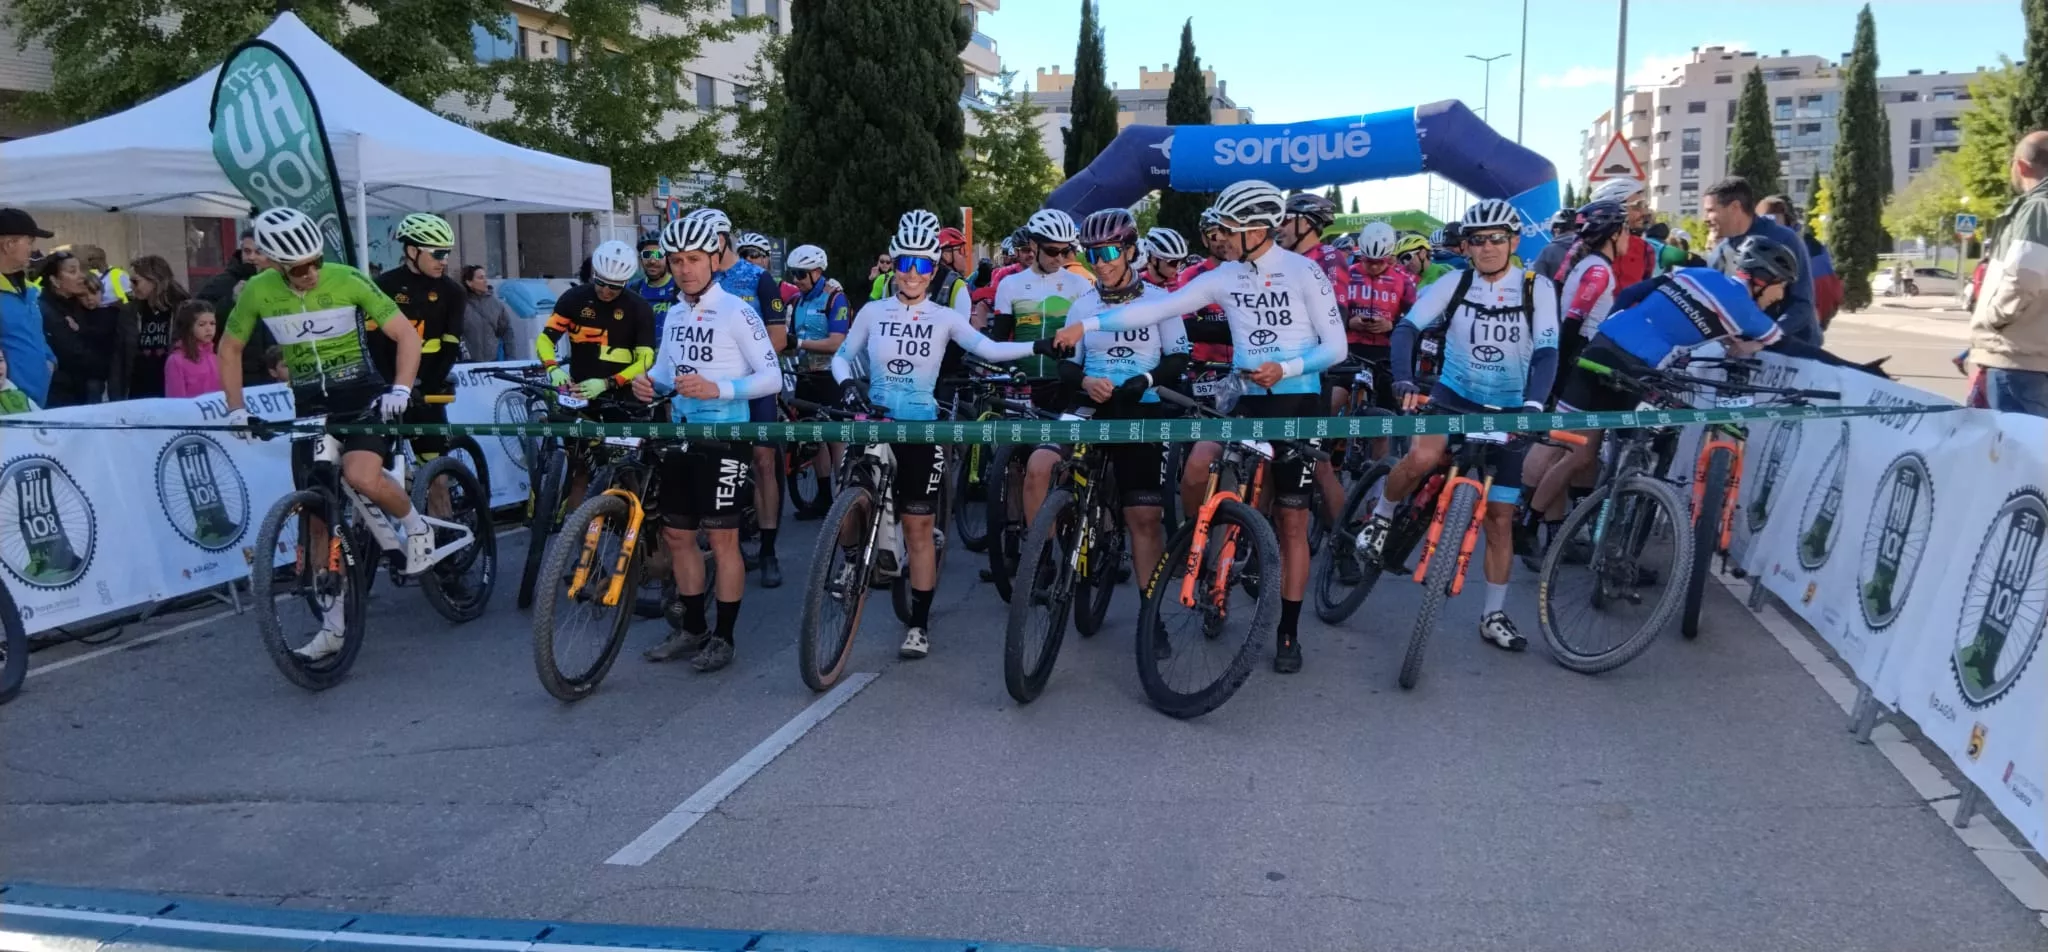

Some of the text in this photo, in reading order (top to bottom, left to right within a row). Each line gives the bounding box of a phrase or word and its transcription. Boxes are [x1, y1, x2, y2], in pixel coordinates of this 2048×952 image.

[1230, 291, 1289, 308] TEAM
[1254, 309, 1293, 326] 108
[670, 326, 714, 344] TEAM
[879, 322, 933, 339] TEAM
[1481, 324, 1521, 343] 108
[680, 345, 713, 362] 108
[896, 340, 930, 357] 108
[1247, 346, 1281, 356] TOYOTA
[1106, 358, 1136, 366] TOYOTA
[1470, 361, 1506, 373] TOYOTA
[885, 375, 914, 385] TOYOTA
[263, 391, 295, 413] BTT
[181, 454, 210, 488] HU
[926, 445, 945, 496] TEAM
[716, 458, 740, 511] TEAM
[21, 478, 51, 517] HU
[190, 486, 217, 505] 108
[1888, 480, 1918, 531] HU
[24, 515, 58, 538] 108
[2000, 526, 2038, 591] HU
[1146, 552, 1170, 599] MAXXIS
[1989, 583, 2021, 625] 108
